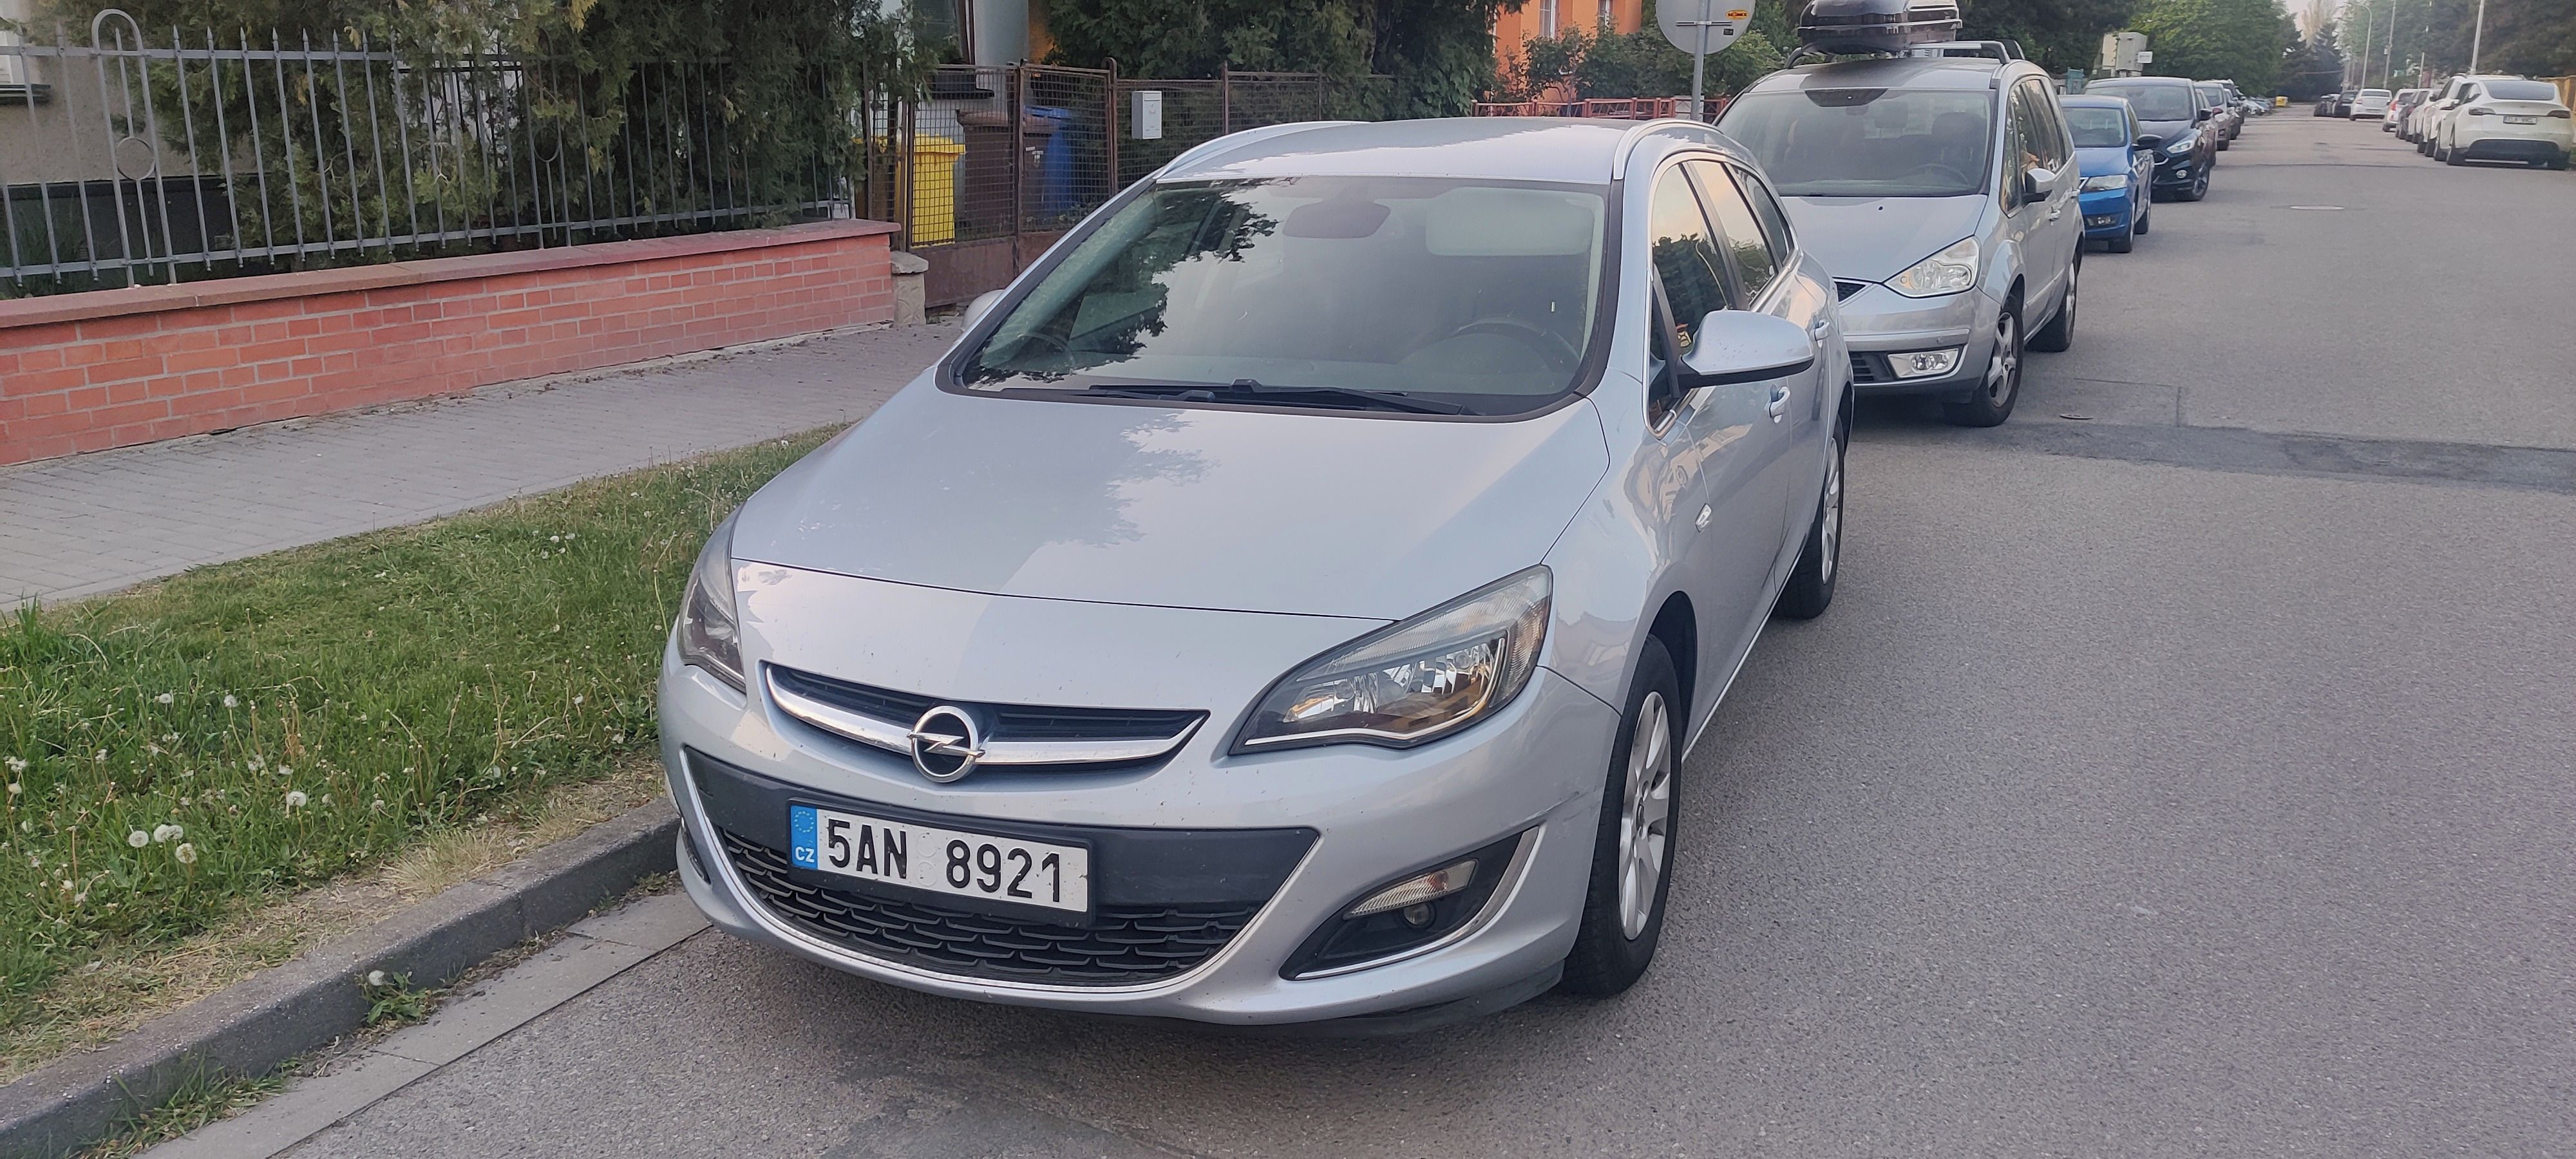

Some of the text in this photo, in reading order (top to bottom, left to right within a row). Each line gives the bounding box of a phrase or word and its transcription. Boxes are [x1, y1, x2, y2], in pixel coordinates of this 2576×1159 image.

[795, 846, 815, 863] CZ
[828, 818, 1060, 903] 5AN 8921
